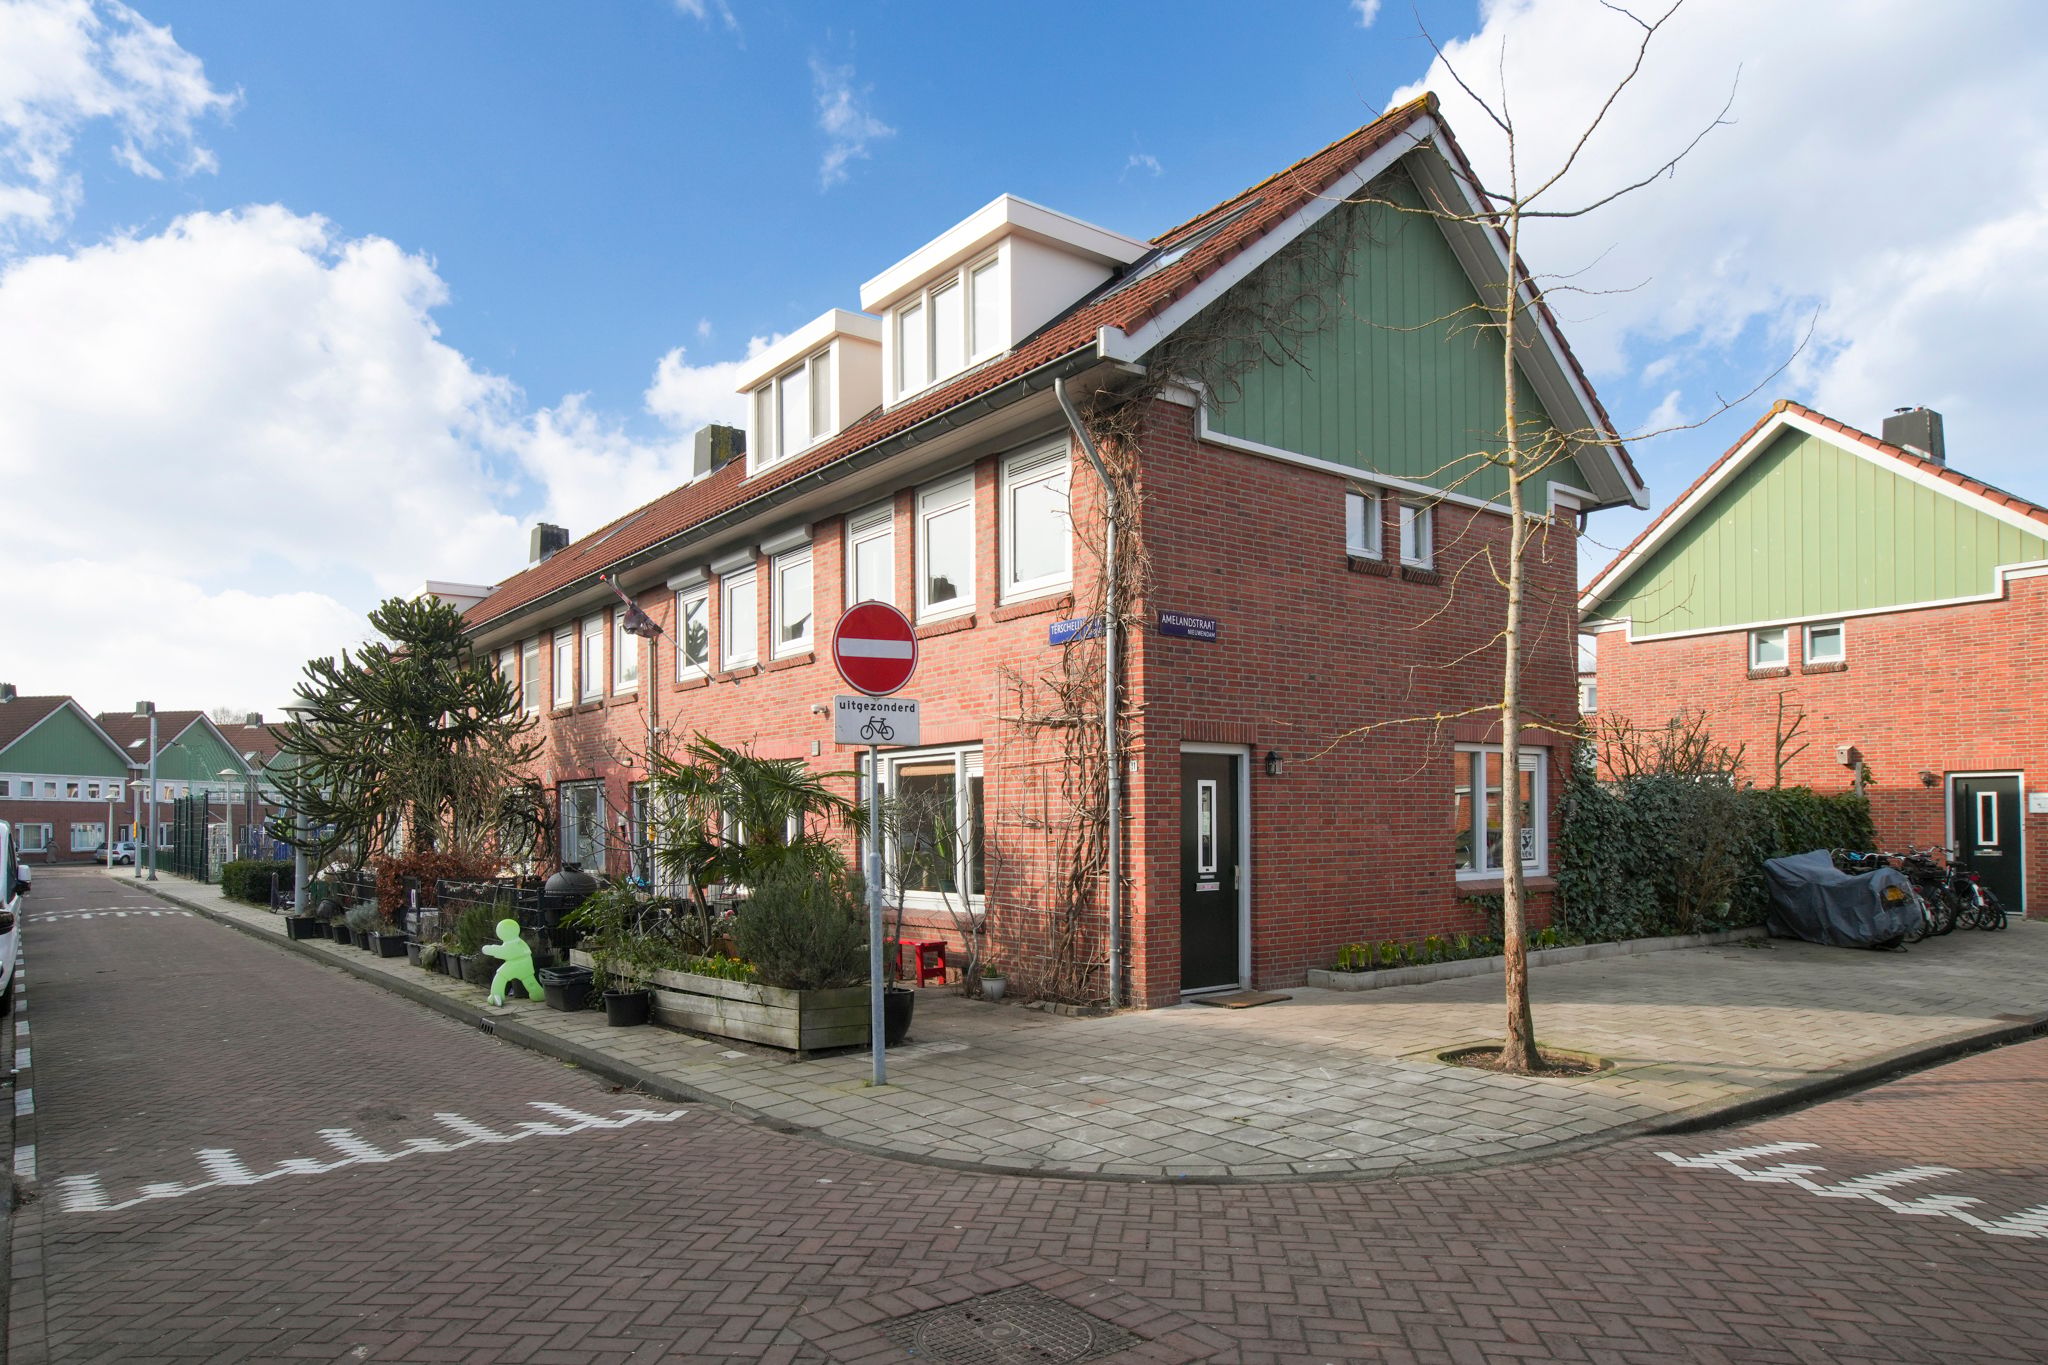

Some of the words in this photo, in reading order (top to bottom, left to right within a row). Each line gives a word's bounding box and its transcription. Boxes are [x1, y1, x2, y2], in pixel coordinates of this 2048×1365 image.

[1161, 614, 1215, 630] AMELANDSTRAAT
[1188, 629, 1216, 638] NIEUWENDAM
[839, 700, 915, 713] uitgezonderd
